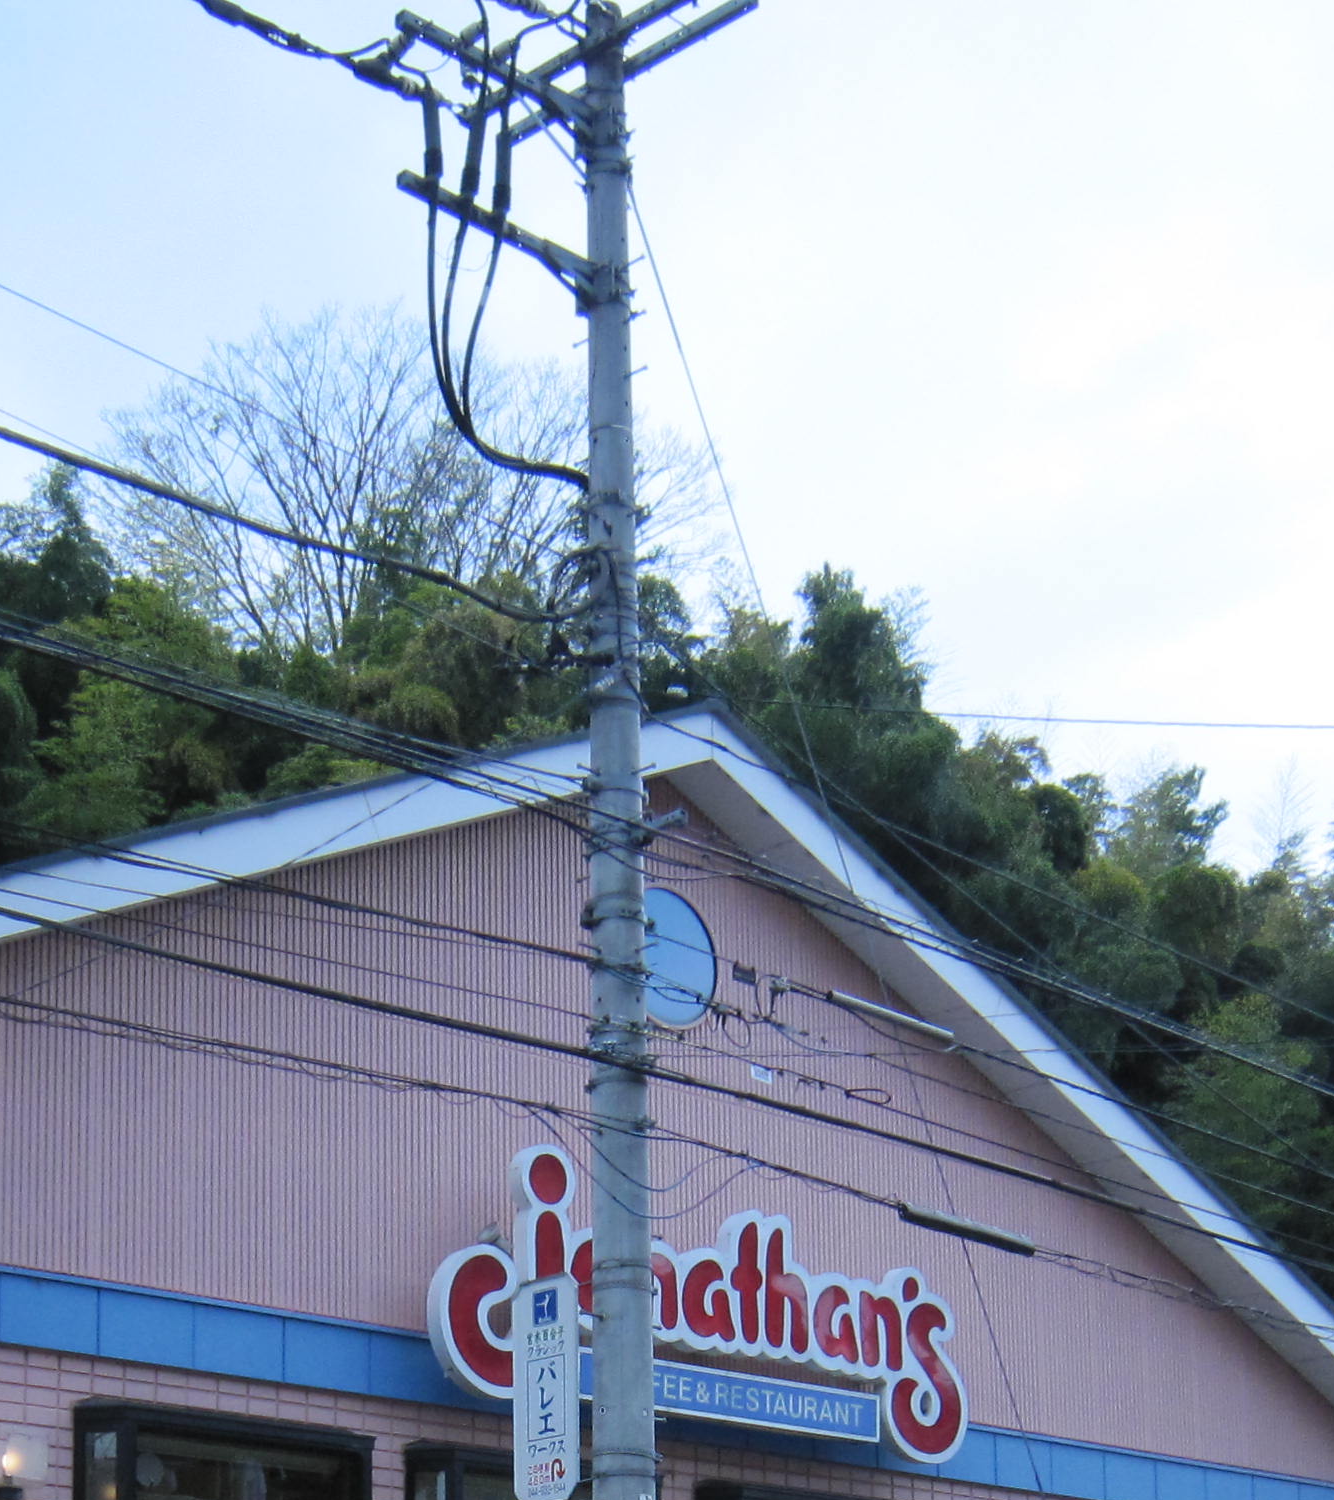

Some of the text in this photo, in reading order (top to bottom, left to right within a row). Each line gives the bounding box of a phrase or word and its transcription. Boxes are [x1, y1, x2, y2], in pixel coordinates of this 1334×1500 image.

[536, 1361, 557, 1435] バレエ
[715, 1382, 863, 1427] RESTAURANT
[528, 1440, 566, 1457] ワークス
